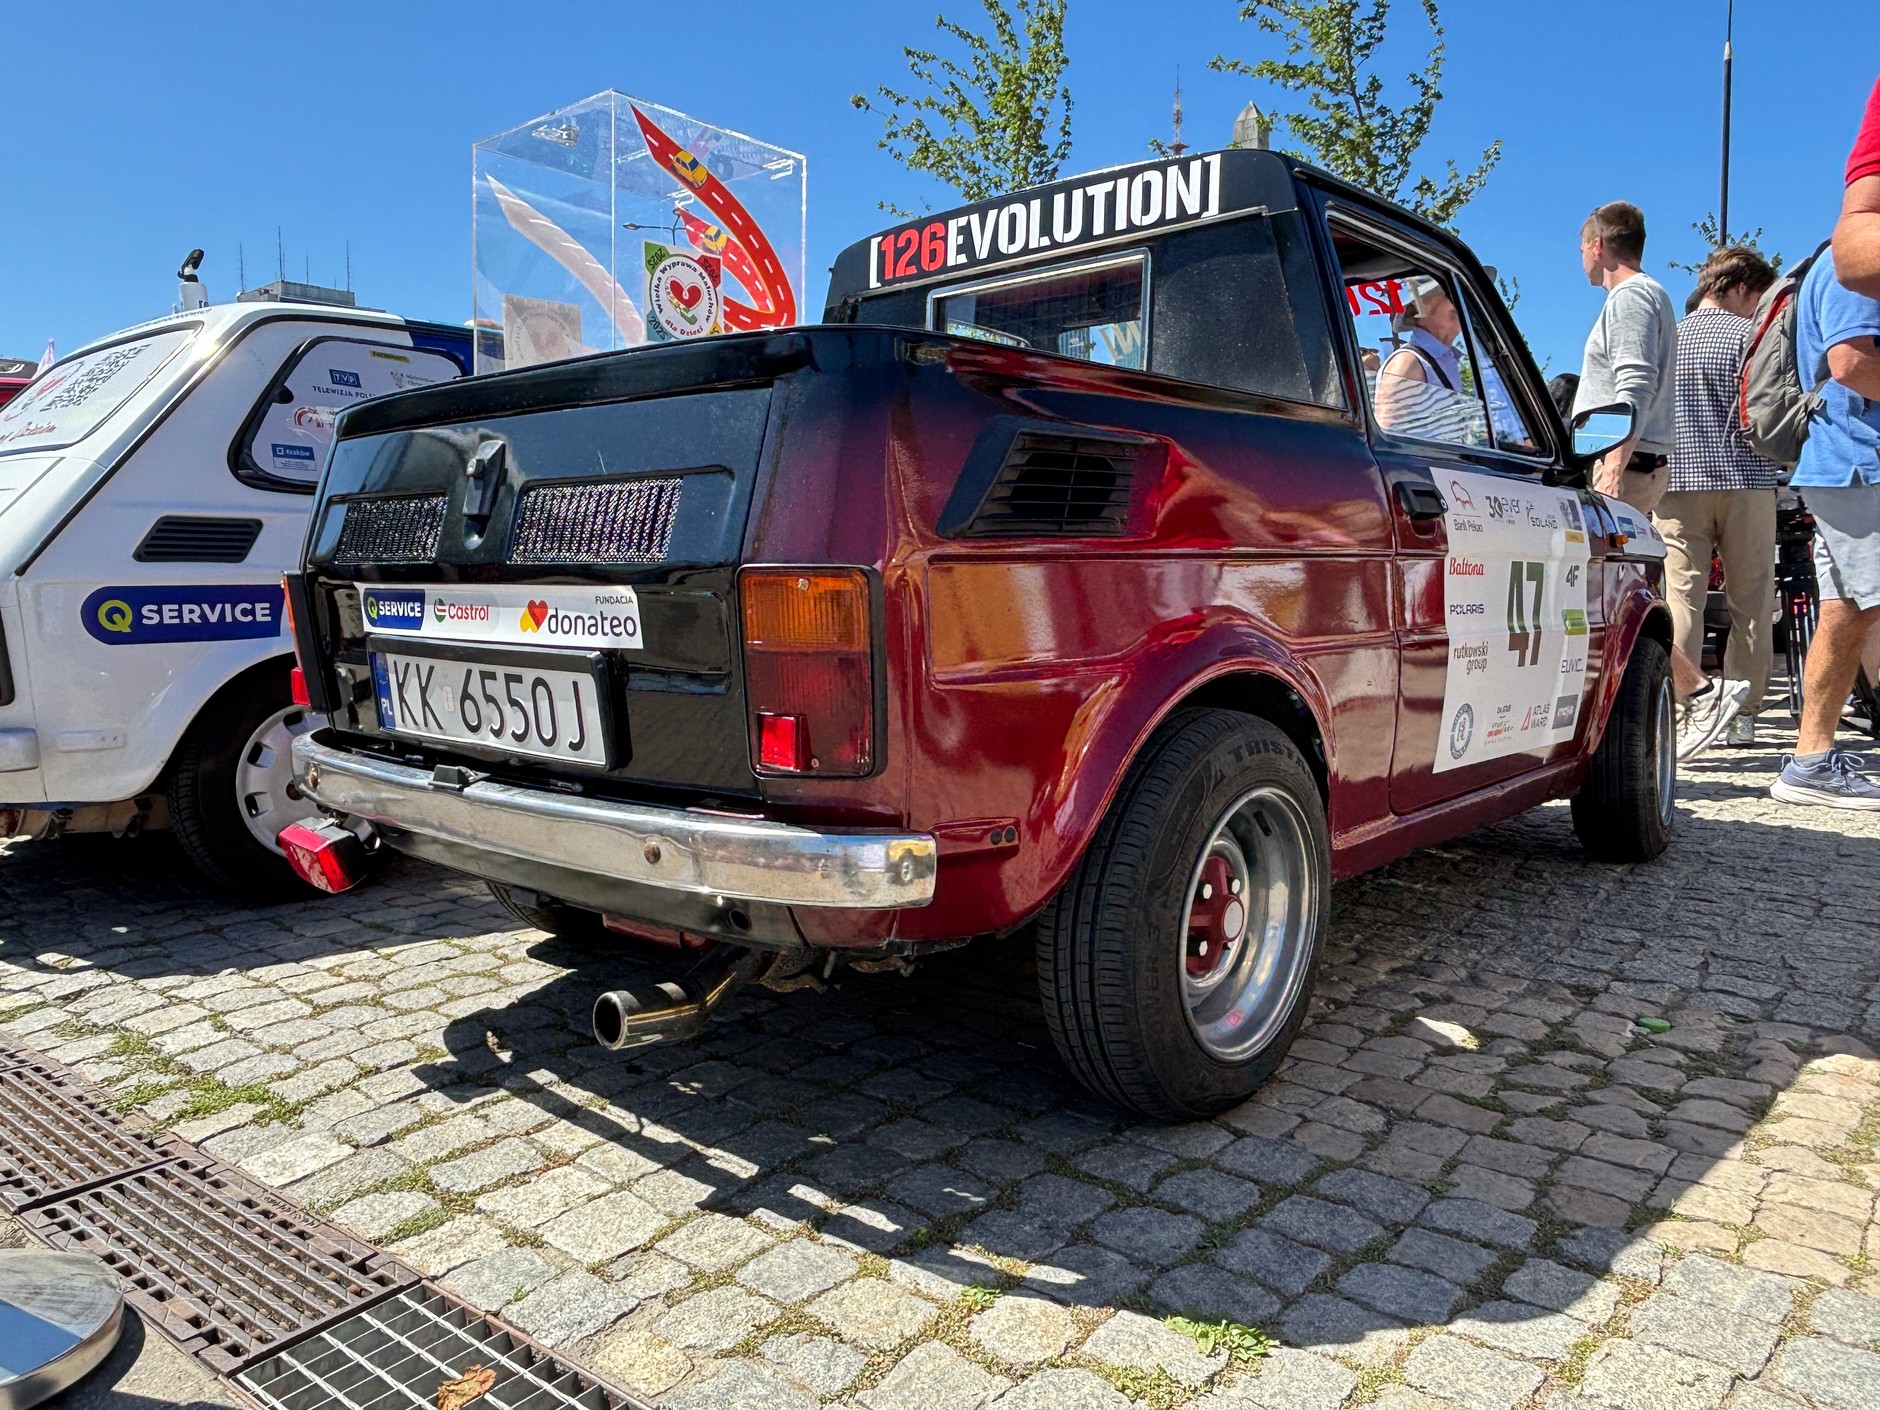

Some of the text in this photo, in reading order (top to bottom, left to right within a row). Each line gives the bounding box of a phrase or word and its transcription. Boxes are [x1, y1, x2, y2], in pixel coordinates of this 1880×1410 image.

[654, 276, 664, 314] Wielka
[660, 261, 698, 275] Wyprawa
[648, 316, 669, 341] 2025
[665, 319, 678, 332] dla
[680, 325, 704, 336] Dzieci
[312, 385, 354, 397] TELEWIZJA
[141, 602, 272, 625] SERVICE
[378, 601, 422, 618] SERVICE
[448, 602, 490, 622] Castrol
[1507, 560, 1544, 667] 47
[547, 607, 637, 637] donateo
[381, 698, 394, 716] PL
[393, 660, 586, 752] KK 6550J
